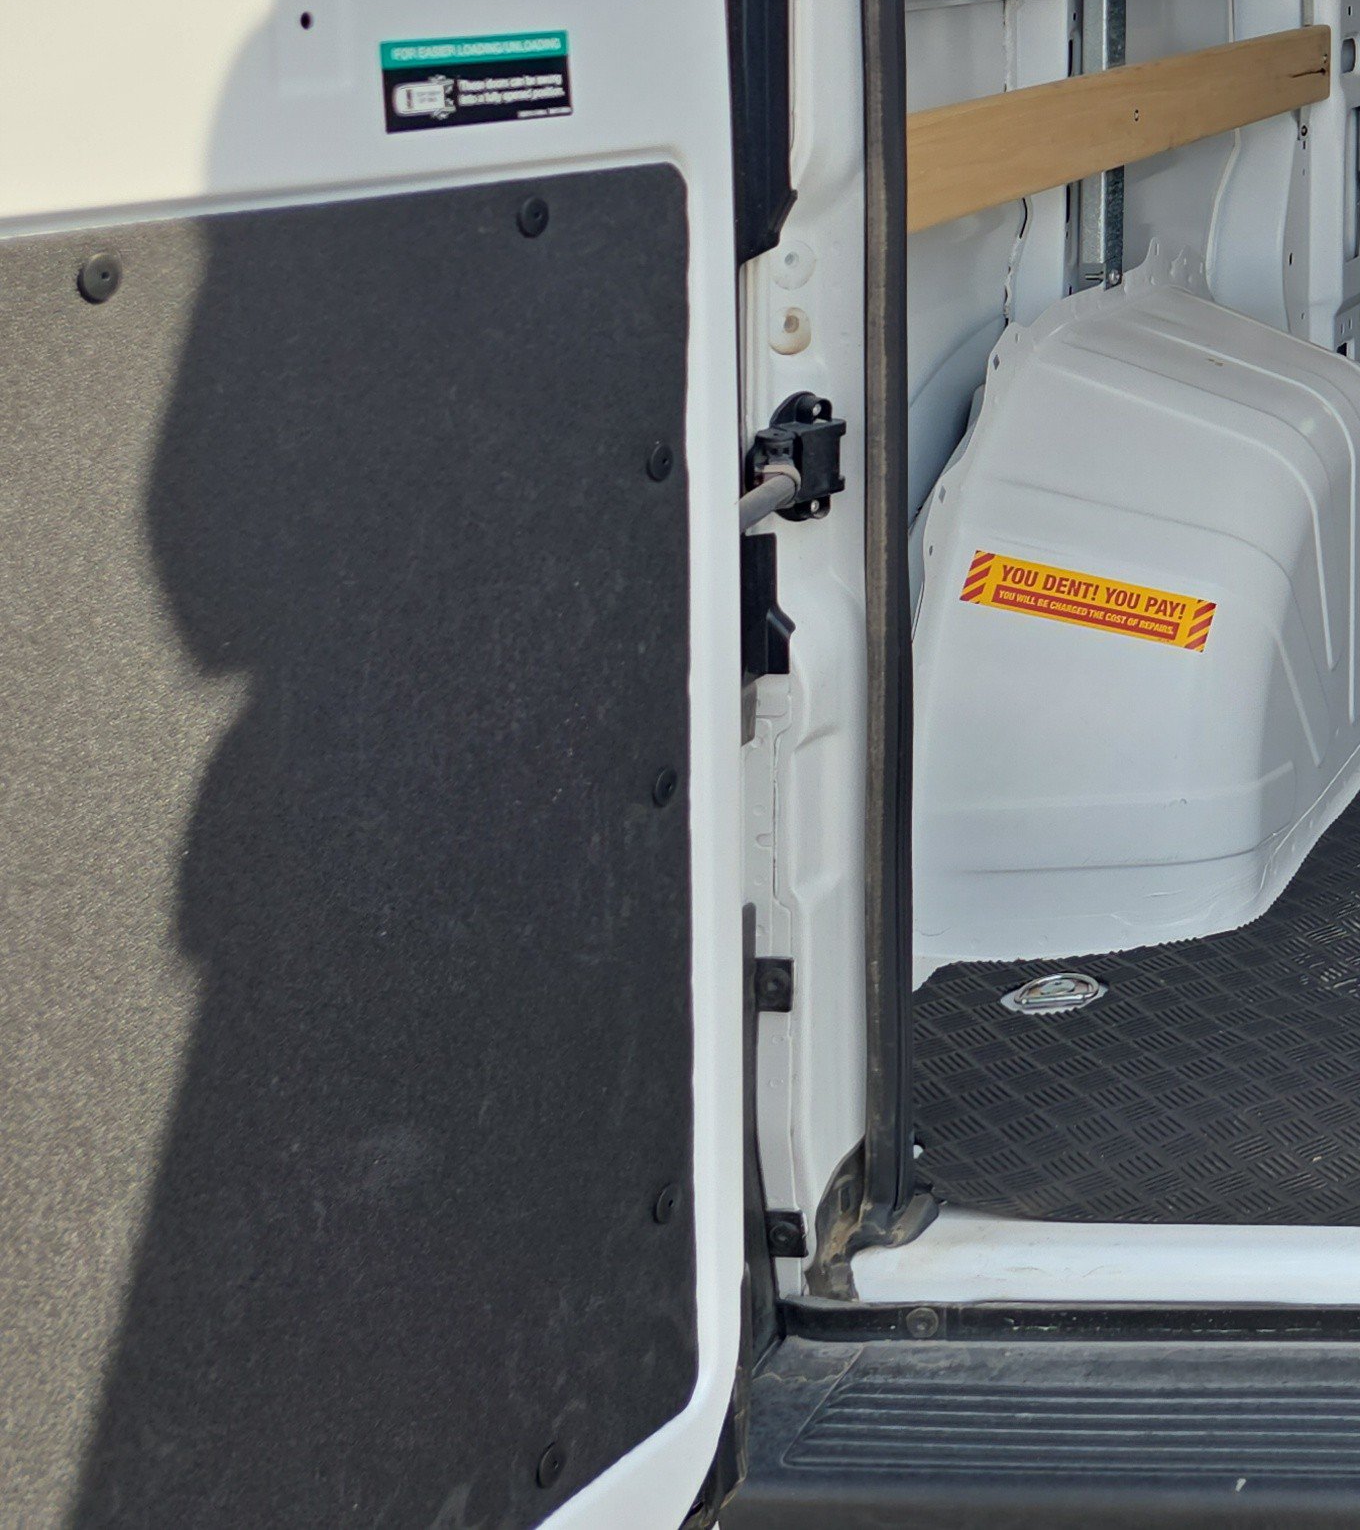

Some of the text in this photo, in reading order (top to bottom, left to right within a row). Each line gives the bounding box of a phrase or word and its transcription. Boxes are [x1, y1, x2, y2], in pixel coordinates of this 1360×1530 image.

[391, 46, 417, 61] FOR
[418, 43, 456, 59] EASIER
[998, 589, 1175, 636] YOU WILL BE CHARGED THE COST OF REPAIRS.
[1001, 564, 1187, 620] YOU DENT! YOU PAY!
